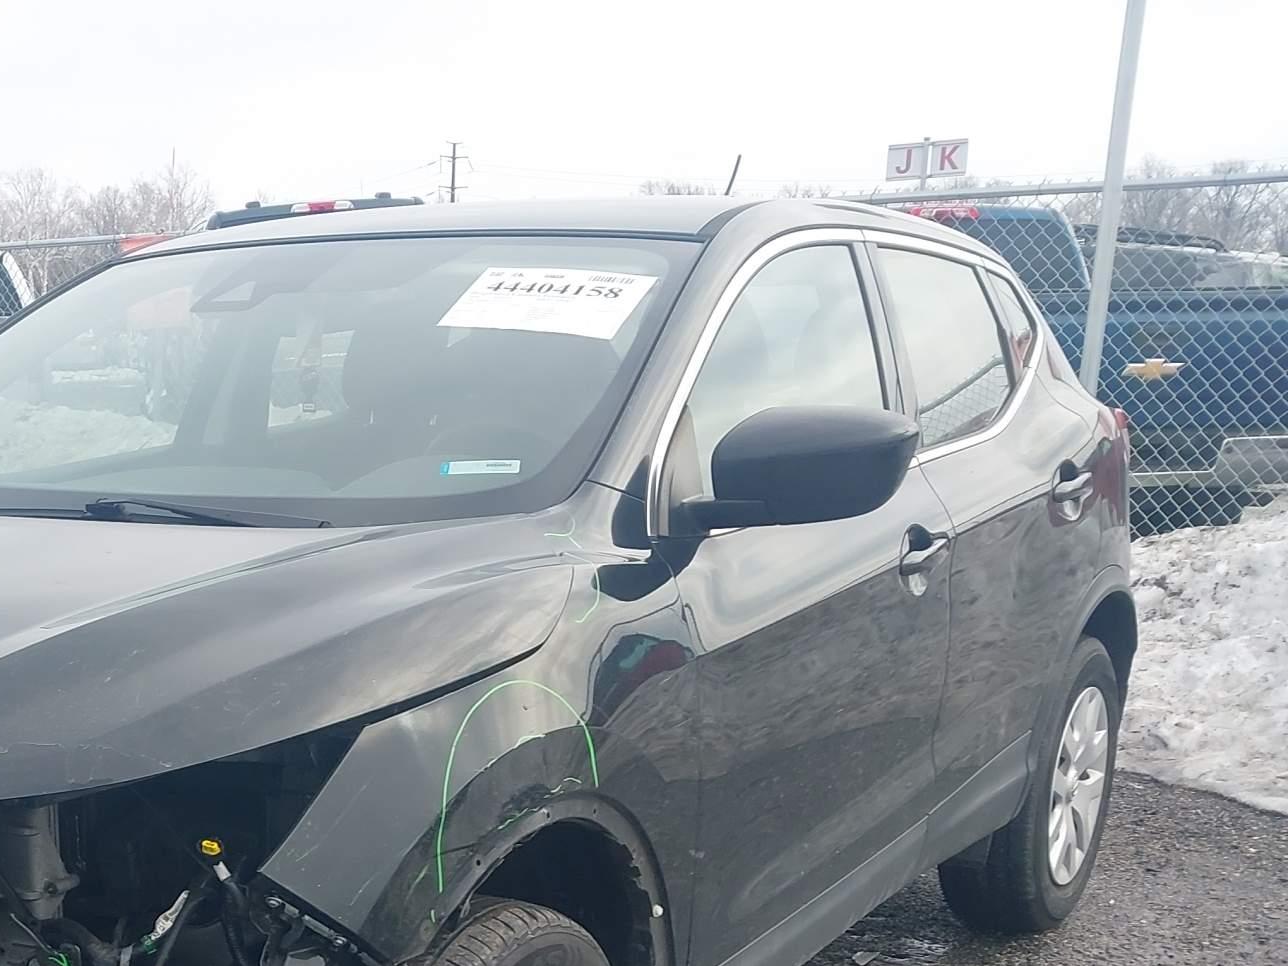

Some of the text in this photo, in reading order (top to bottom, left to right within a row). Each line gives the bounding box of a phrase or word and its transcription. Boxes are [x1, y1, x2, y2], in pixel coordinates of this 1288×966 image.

[895, 148, 913, 175] J
[939, 145, 960, 171] K
[487, 280, 623, 299] 44404158
